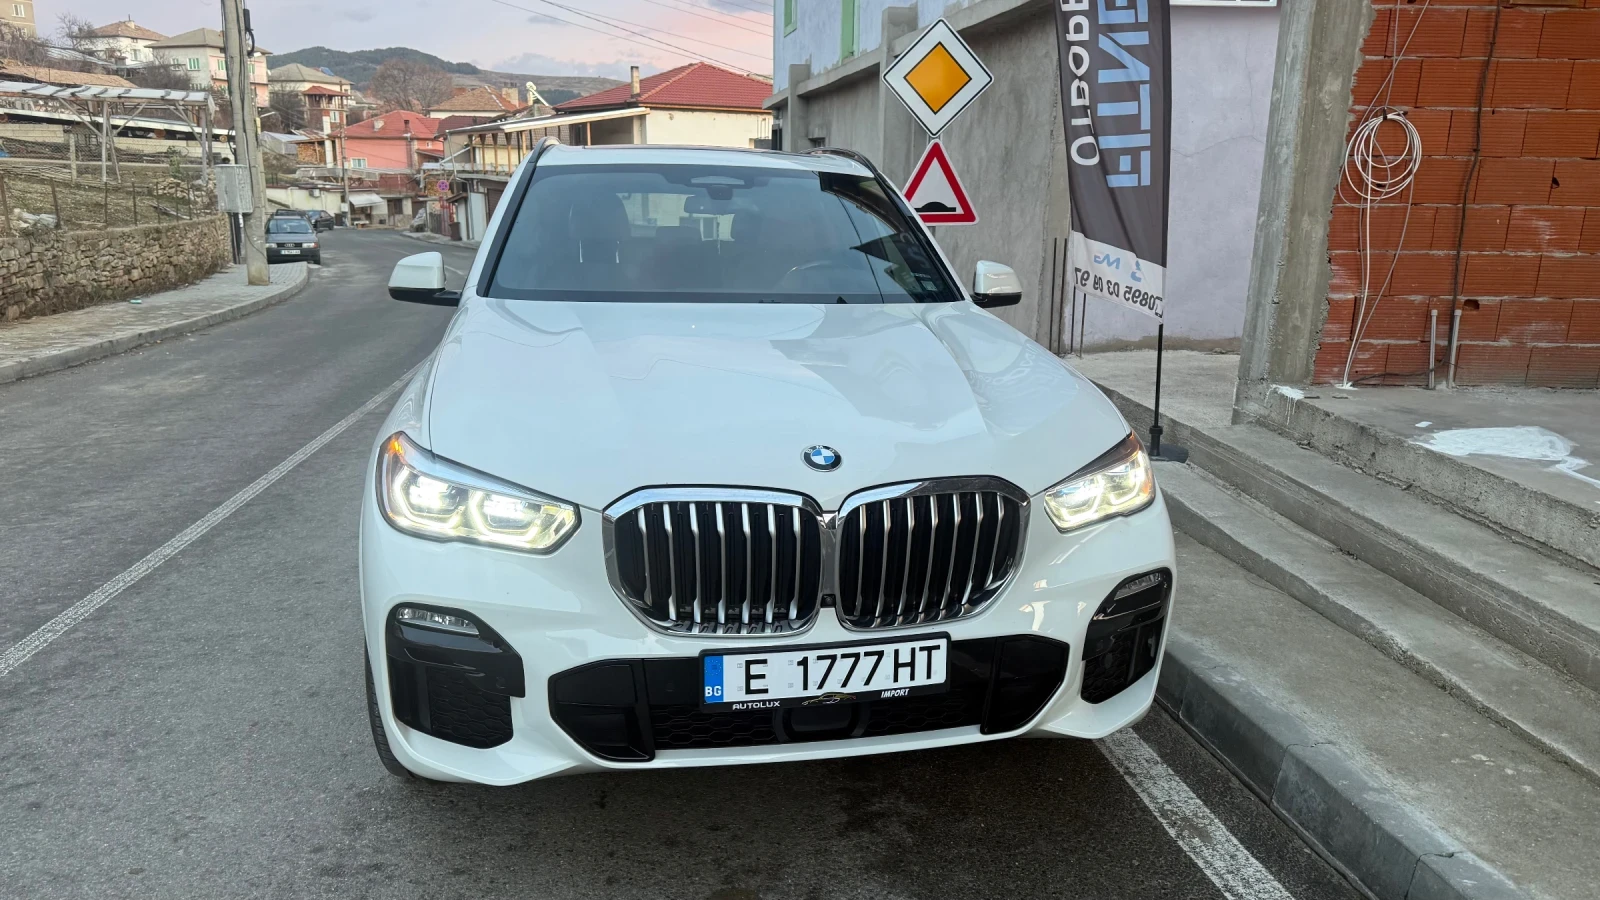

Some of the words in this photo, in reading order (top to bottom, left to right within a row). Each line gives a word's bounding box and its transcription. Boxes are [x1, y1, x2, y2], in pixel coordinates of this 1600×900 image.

[744, 658, 769, 695] E
[704, 686, 722, 698] BG
[732, 701, 781, 711] AUTOLUX
[880, 688, 910, 699] IMPORT
